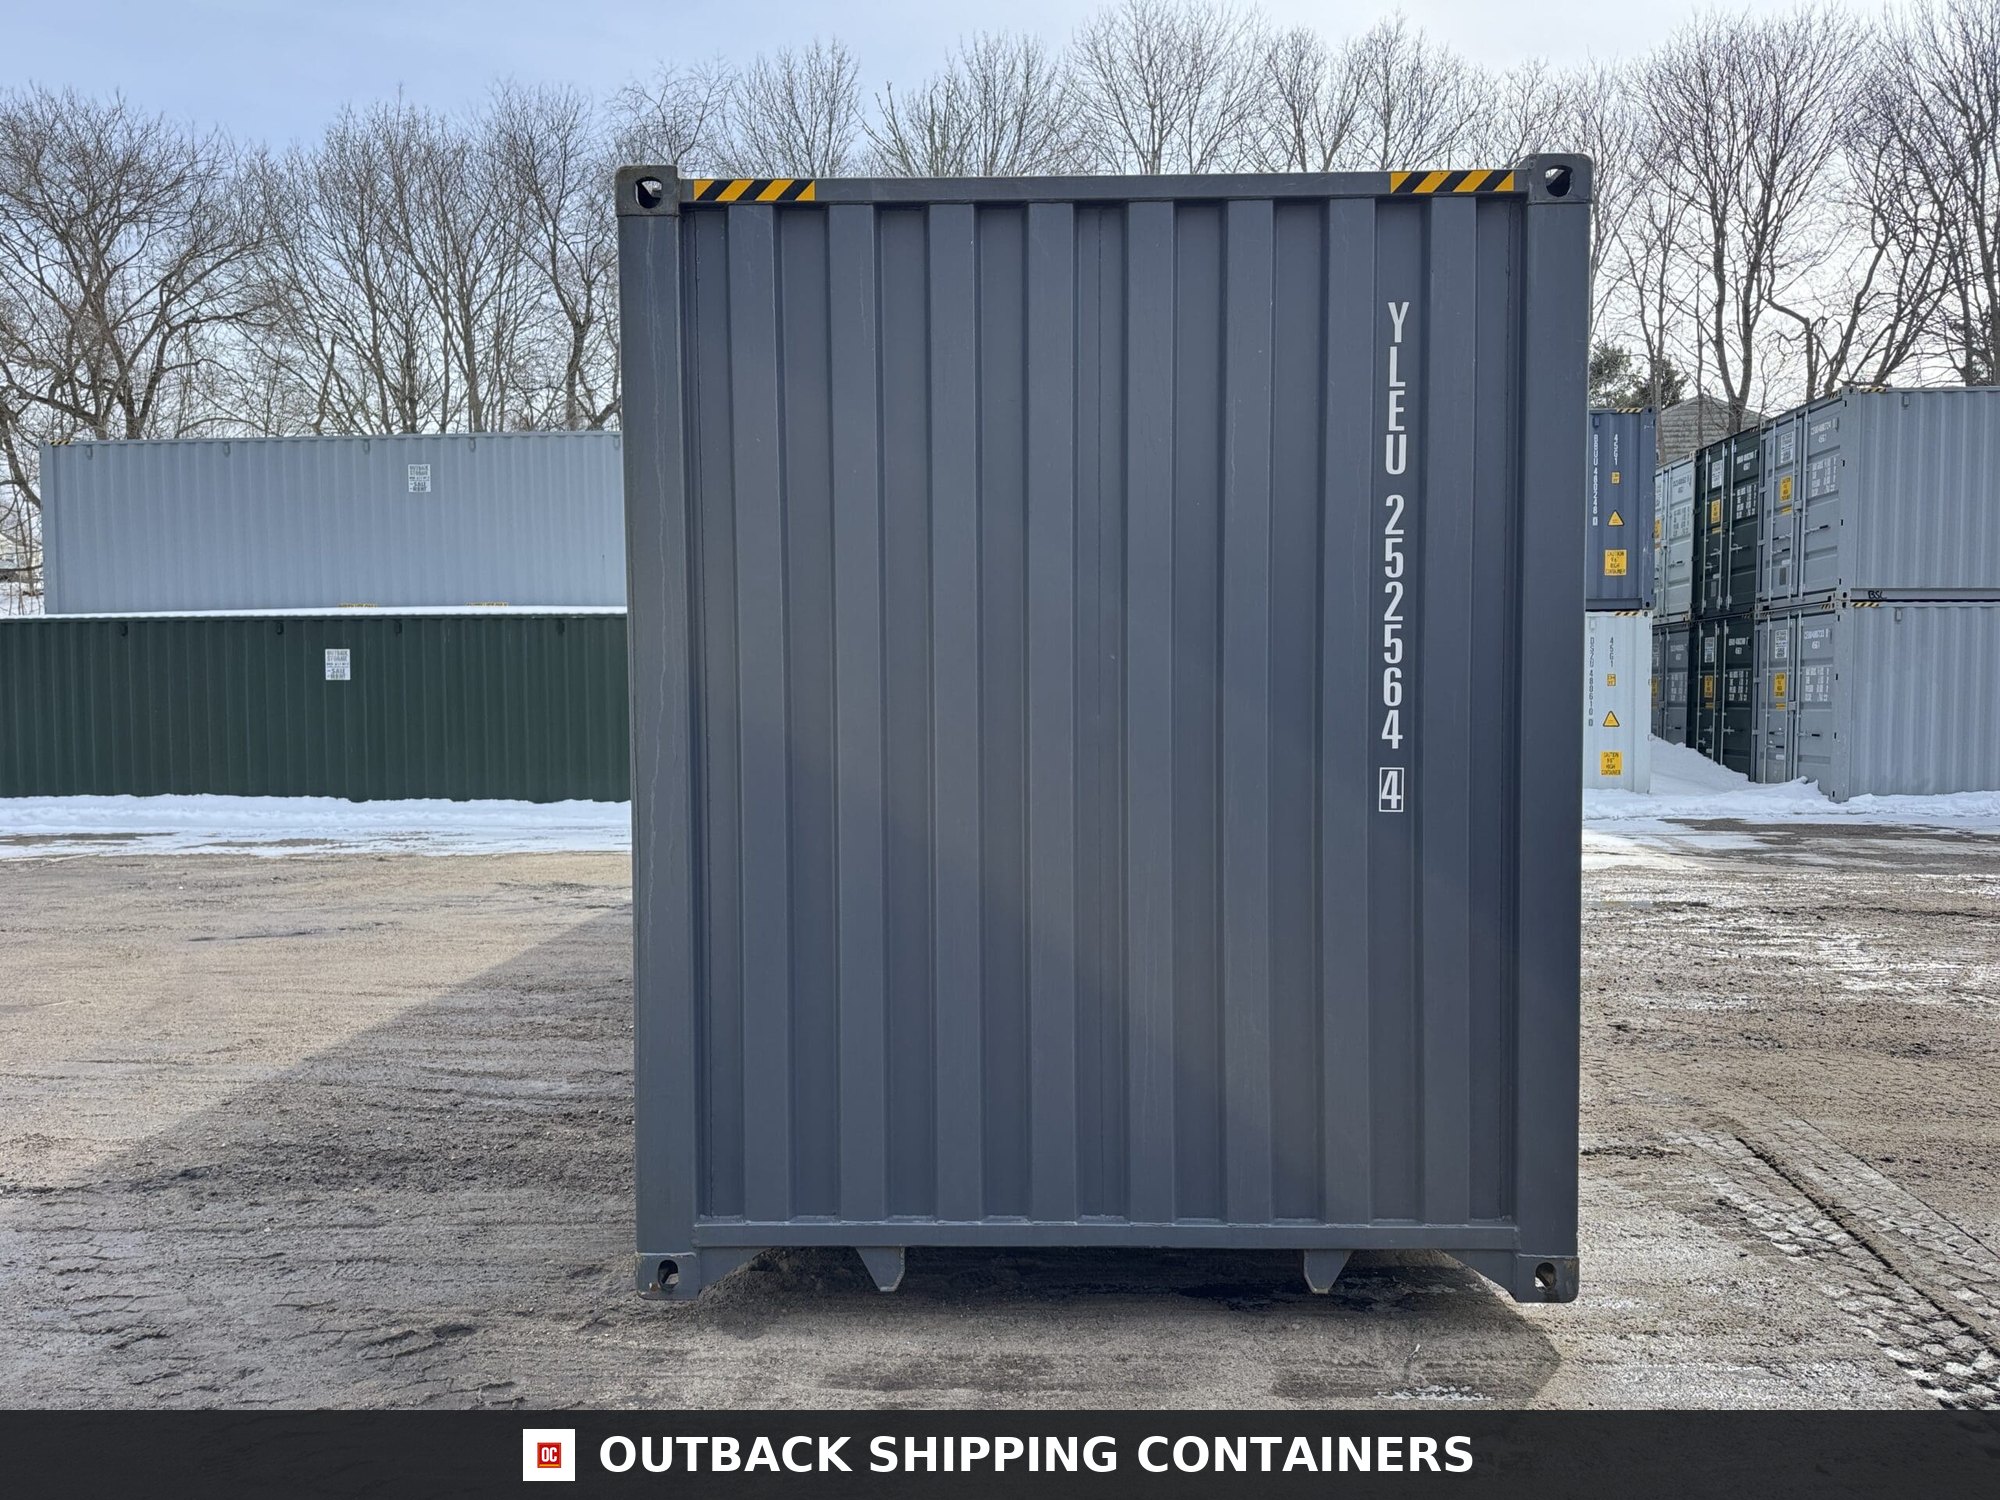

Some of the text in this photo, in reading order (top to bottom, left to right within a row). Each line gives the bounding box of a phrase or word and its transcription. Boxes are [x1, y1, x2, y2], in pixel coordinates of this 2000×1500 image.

[1380, 301, 1410, 810] YLEU 252564 4
